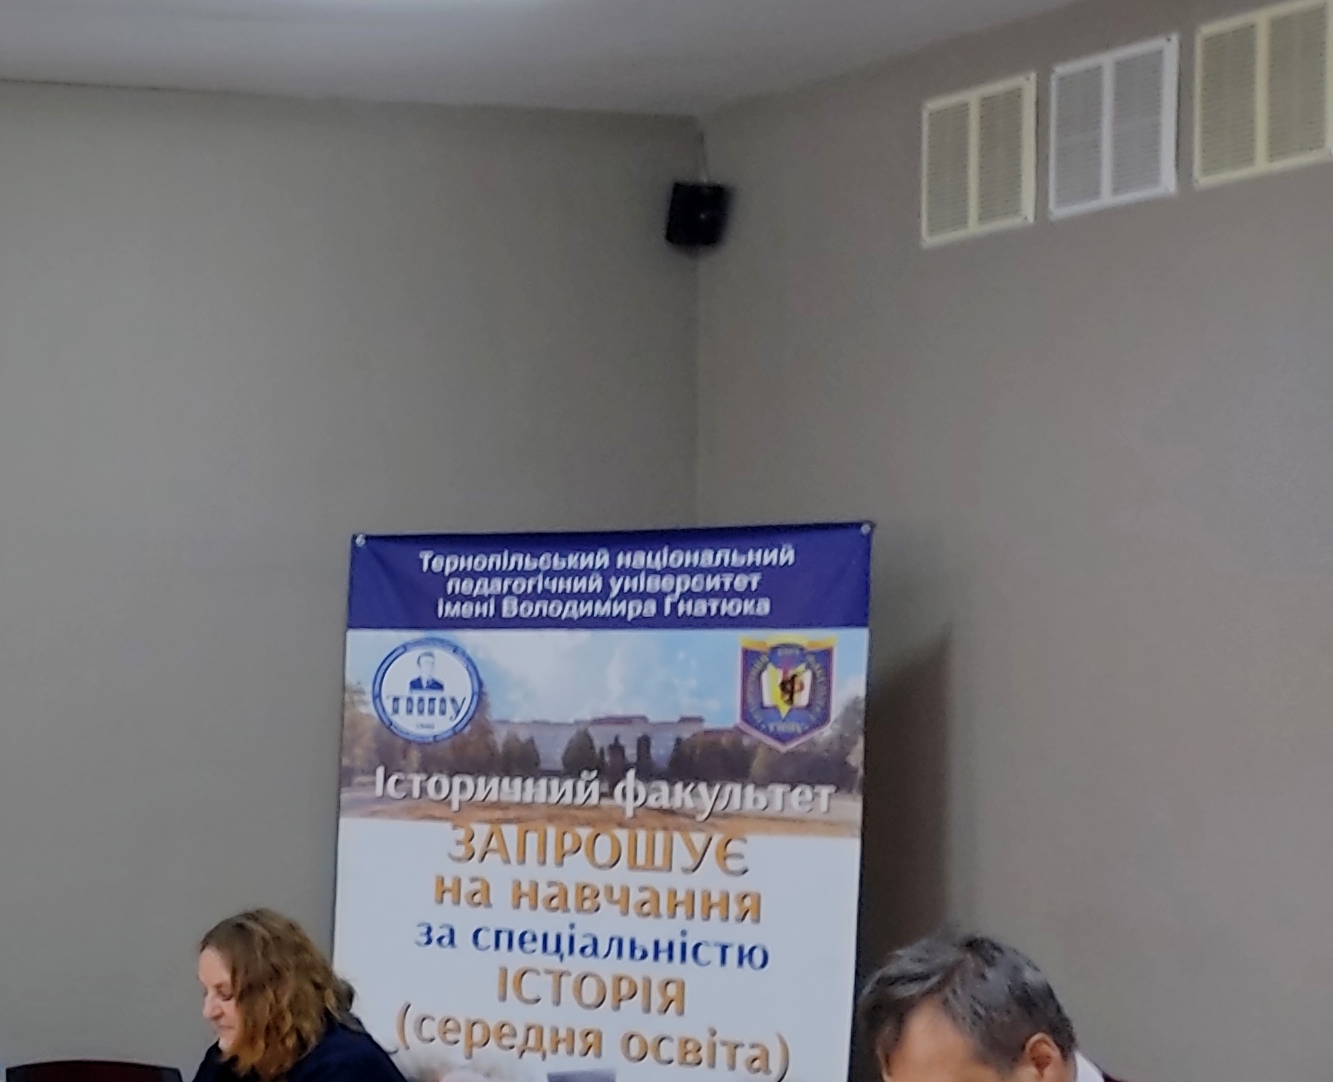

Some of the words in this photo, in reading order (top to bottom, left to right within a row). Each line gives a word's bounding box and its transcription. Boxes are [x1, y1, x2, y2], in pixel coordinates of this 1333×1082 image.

[419, 548, 610, 576] Тернопільський
[617, 543, 796, 572] національний
[447, 572, 603, 597] педагогічний
[609, 571, 763, 599] університет
[501, 595, 658, 622] Володимира
[374, 765, 601, 813] Історичний
[613, 768, 838, 821] факультет
[447, 820, 750, 877] ЗАПРОШУЄ
[434, 874, 493, 909] на
[511, 877, 763, 924] навчання
[414, 921, 457, 950] за
[471, 923, 770, 971] спеціальністю
[497, 965, 688, 1018] ІСТОРІЯ
[395, 1001, 604, 1060] (середня
